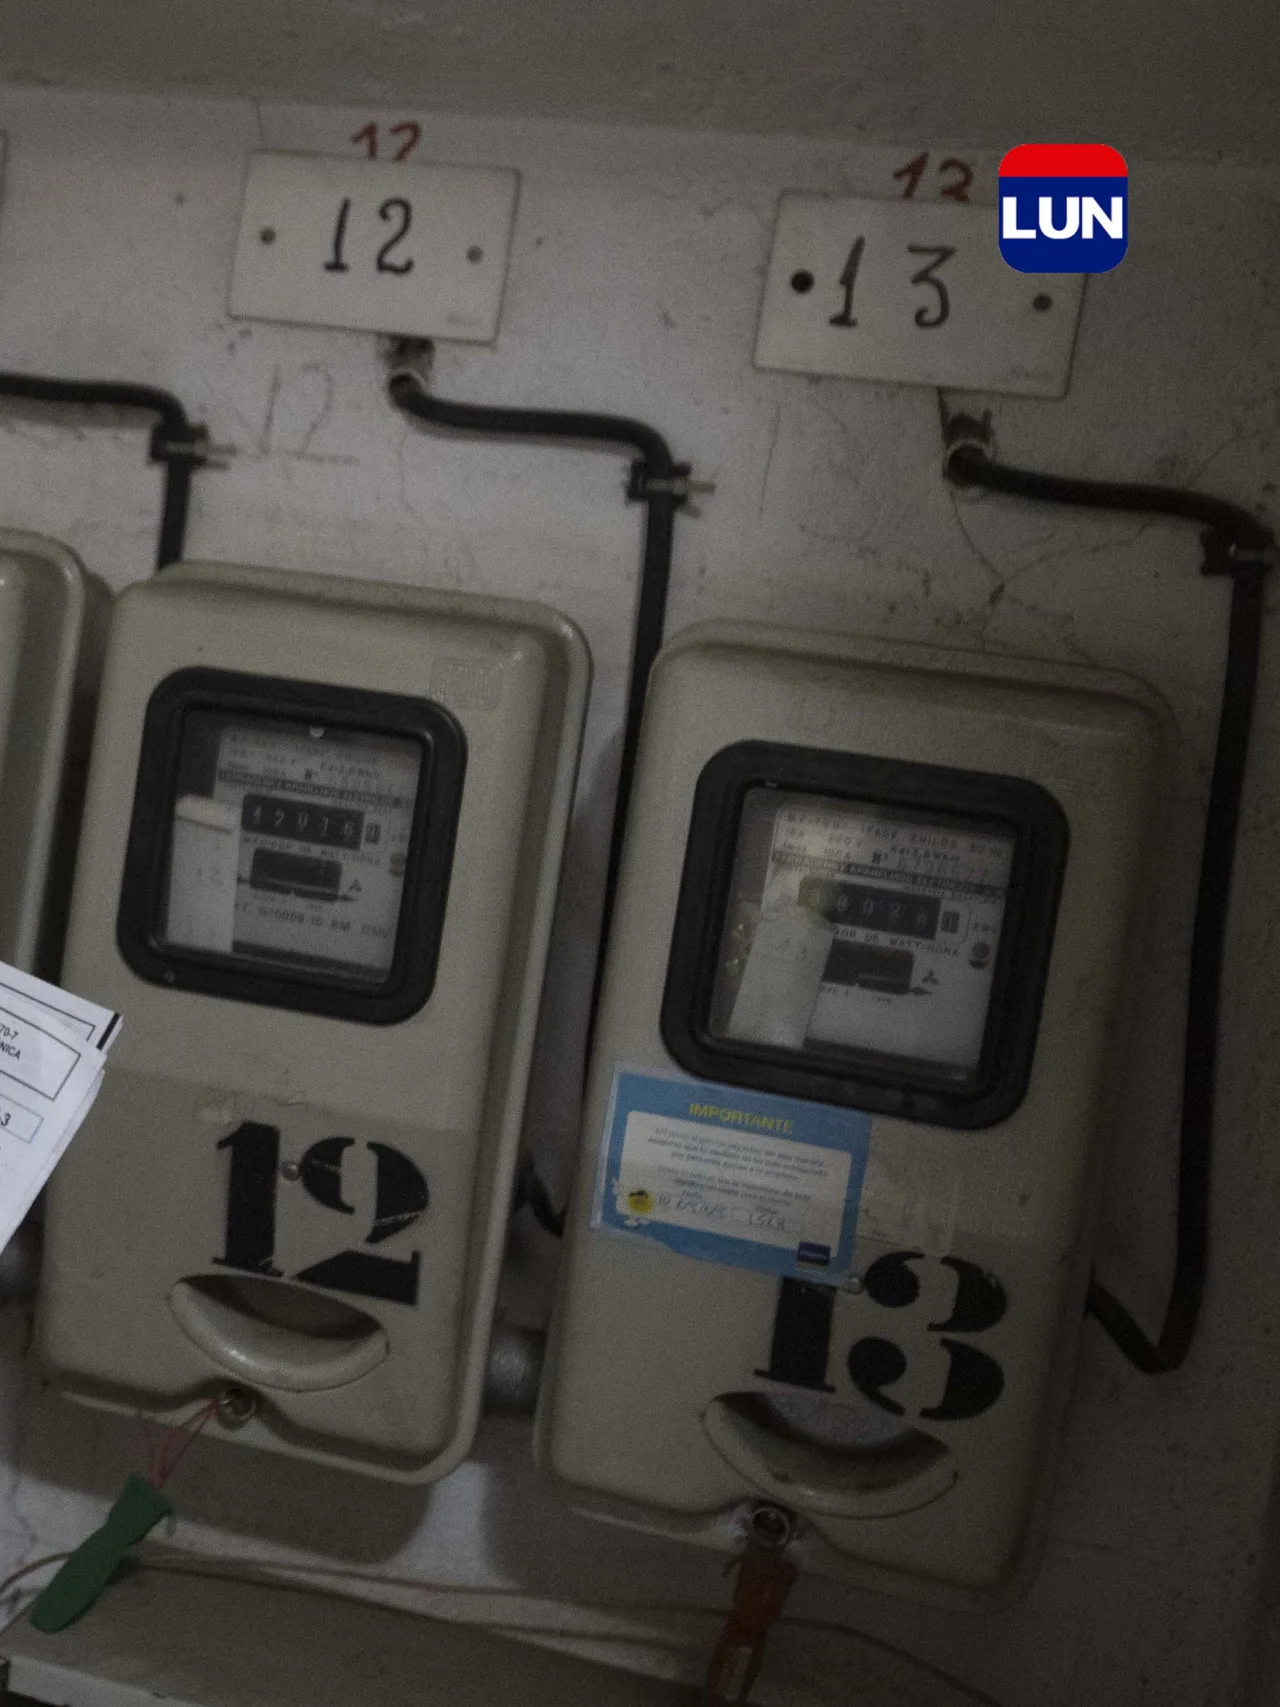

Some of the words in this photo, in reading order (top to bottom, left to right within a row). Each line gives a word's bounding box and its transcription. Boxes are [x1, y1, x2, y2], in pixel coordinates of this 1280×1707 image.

[322, 198, 413, 274] 12
[829, 236, 957, 328] 13
[687, 1101, 795, 1136] IMPORTANTE
[212, 1120, 429, 1307] 12
[753, 1250, 1009, 1422] 13
